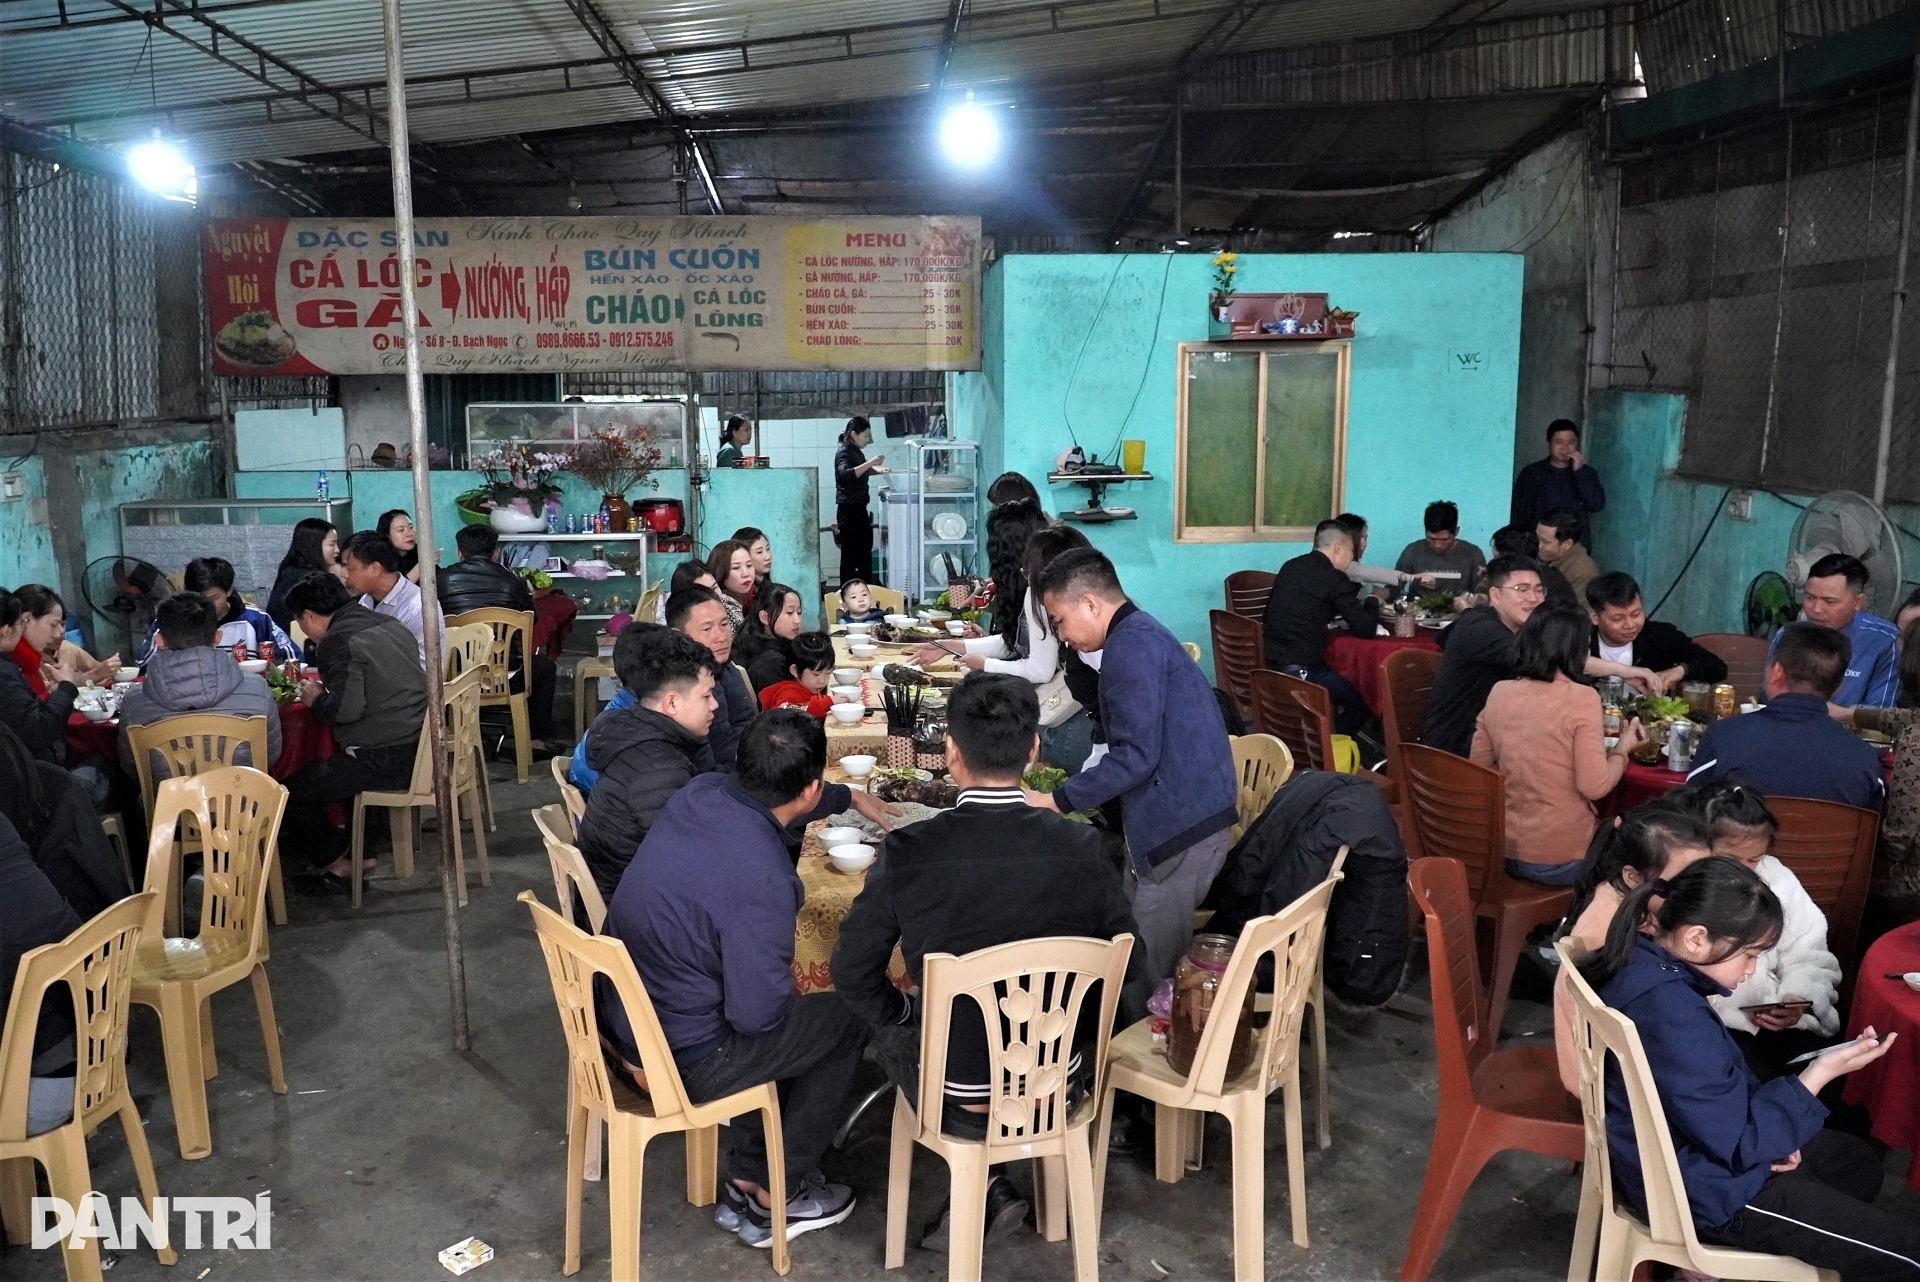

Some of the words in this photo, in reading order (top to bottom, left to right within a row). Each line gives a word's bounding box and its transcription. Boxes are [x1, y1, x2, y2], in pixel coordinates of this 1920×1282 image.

[846, 233, 906, 247] MENU
[584, 243, 656, 270] BÚN
[668, 240, 760, 270] CUỐN
[290, 252, 344, 288] CÁ
[357, 252, 432, 288] LÓC
[631, 273, 669, 284] XÀO
[716, 273, 754, 284] XÀO
[693, 287, 721, 305] CÁ
[728, 287, 766, 305] LÓC
[944, 289, 961, 298] 30K
[296, 292, 433, 328] GÀ
[586, 288, 670, 324] CHÁO
[944, 305, 961, 314] 30K
[945, 320, 963, 330] 30K
[426, 333, 437, 348] Số
[439, 335, 445, 347] 8
[463, 335, 484, 349] Bạch
[486, 335, 508, 350] Ngọc
[536, 332, 600, 348] 0989.8666.53
[609, 331, 673, 348] 0912.575.246
[1457, 352, 1482, 365] WC
[1844, 668, 1862, 678] Dior
